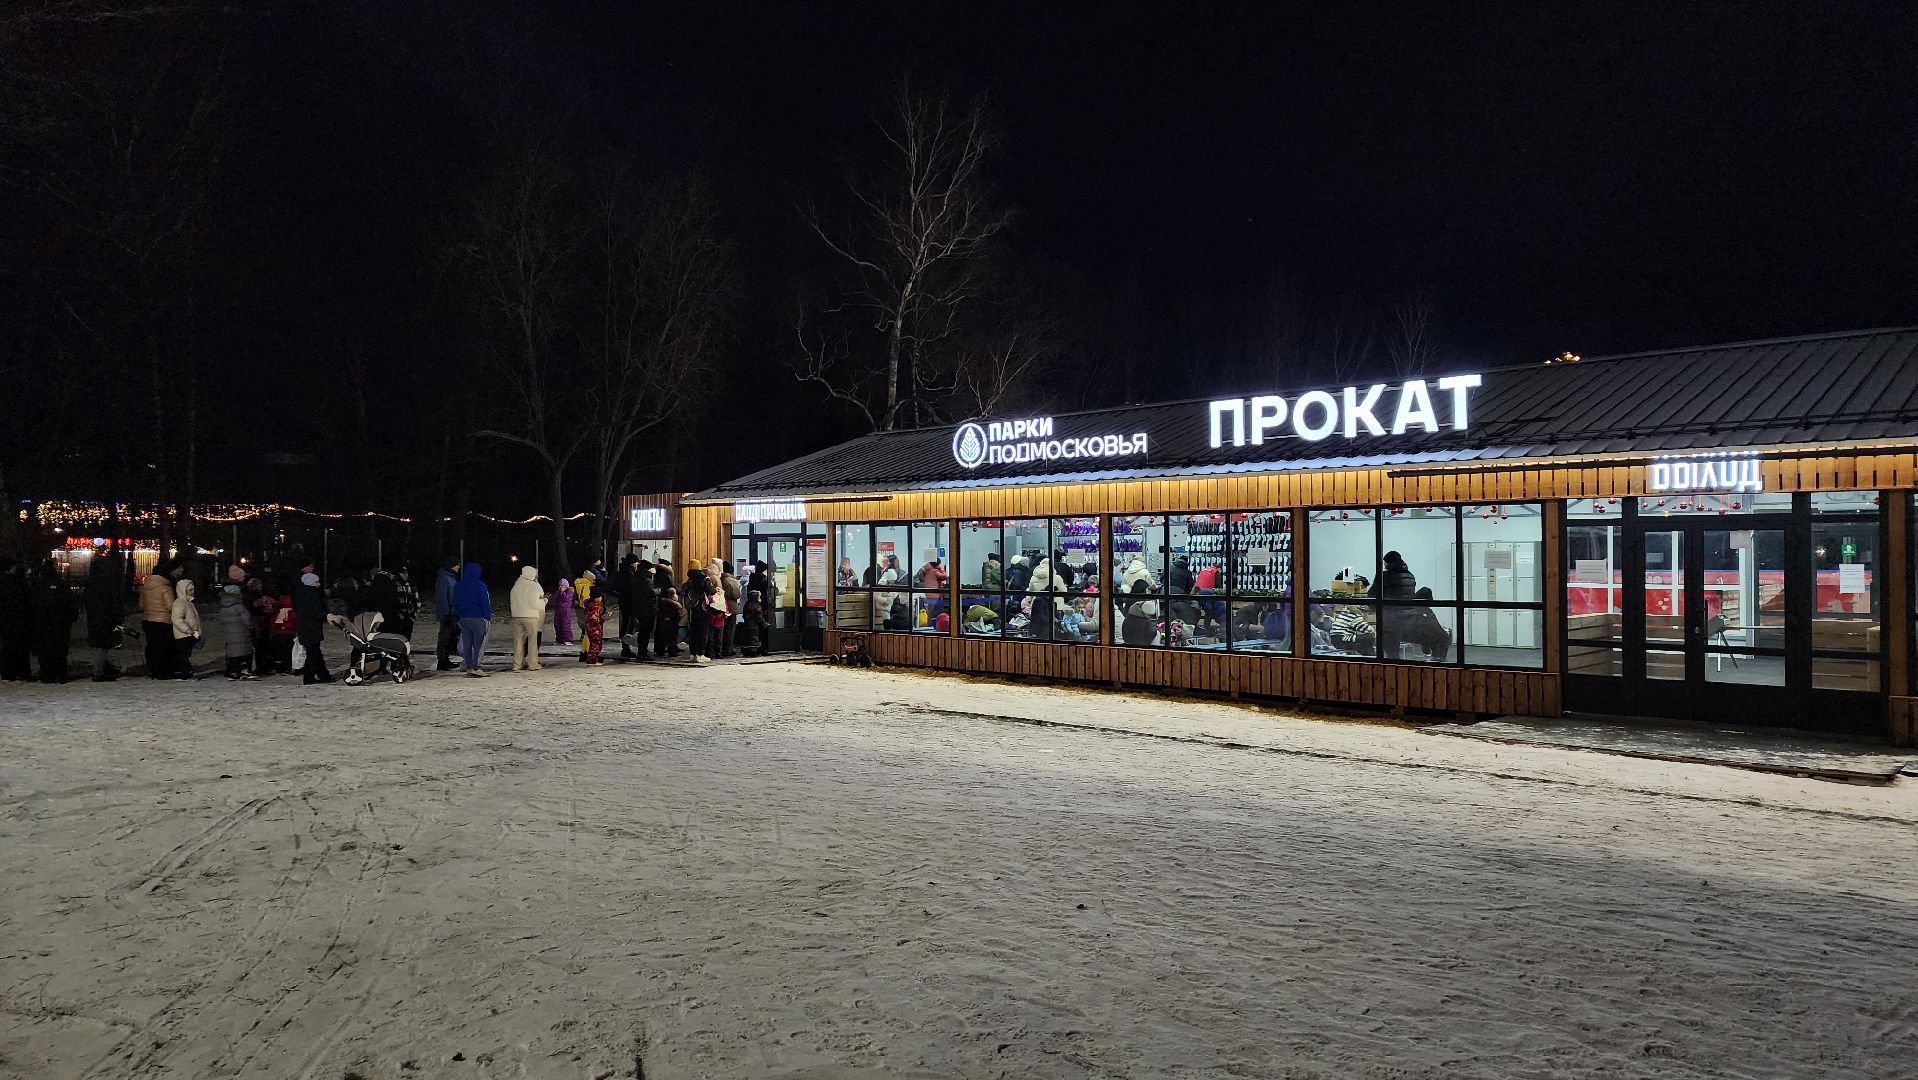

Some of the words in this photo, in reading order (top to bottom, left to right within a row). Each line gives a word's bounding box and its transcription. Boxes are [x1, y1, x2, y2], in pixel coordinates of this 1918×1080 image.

[1209, 374, 1482, 448] ПРОКАТ
[989, 417, 1053, 442] ПАРКИ
[989, 433, 1148, 464] ПОДМОСКОВЬЯ
[632, 509, 666, 531] БИЛЕТЫ
